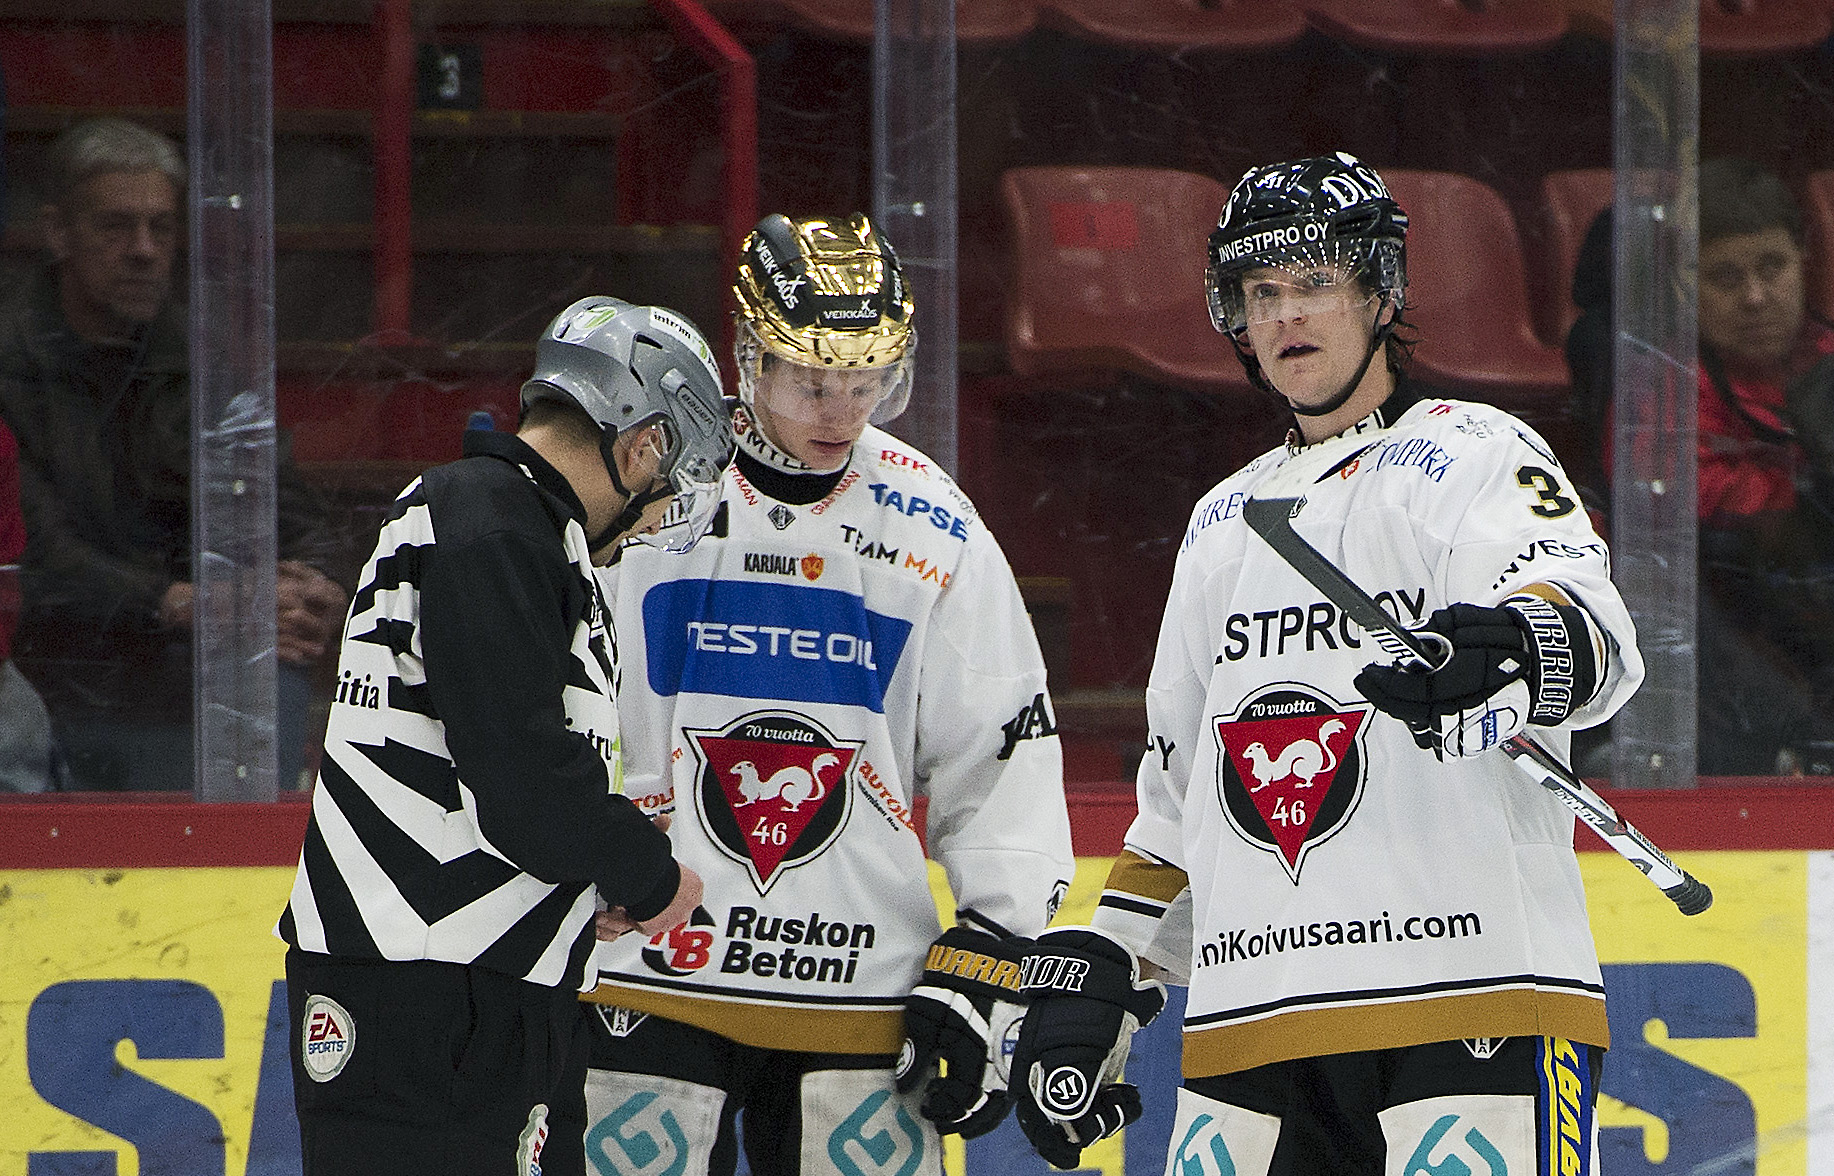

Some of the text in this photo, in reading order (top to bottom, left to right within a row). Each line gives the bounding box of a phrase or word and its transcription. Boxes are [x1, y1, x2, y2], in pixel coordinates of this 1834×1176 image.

[1217, 221, 1329, 264] INVESTPRO OY
[881, 449, 929, 477] RTK
[1514, 465, 1579, 521] 3
[743, 551, 797, 577] KARJALA
[826, 632, 878, 671] OIL
[1249, 698, 1318, 718] 70 vuotta
[745, 724, 815, 744] 70 vuotta
[1270, 796, 1308, 829] 46
[751, 816, 788, 847] 46
[725, 904, 877, 950] Ruskon
[1198, 910, 1483, 969] niKoivusaari.com
[720, 940, 860, 985] Betoni
[924, 944, 1021, 991] WARR
[309, 1011, 345, 1041] EA
[307, 1040, 347, 1056] SPORTS
